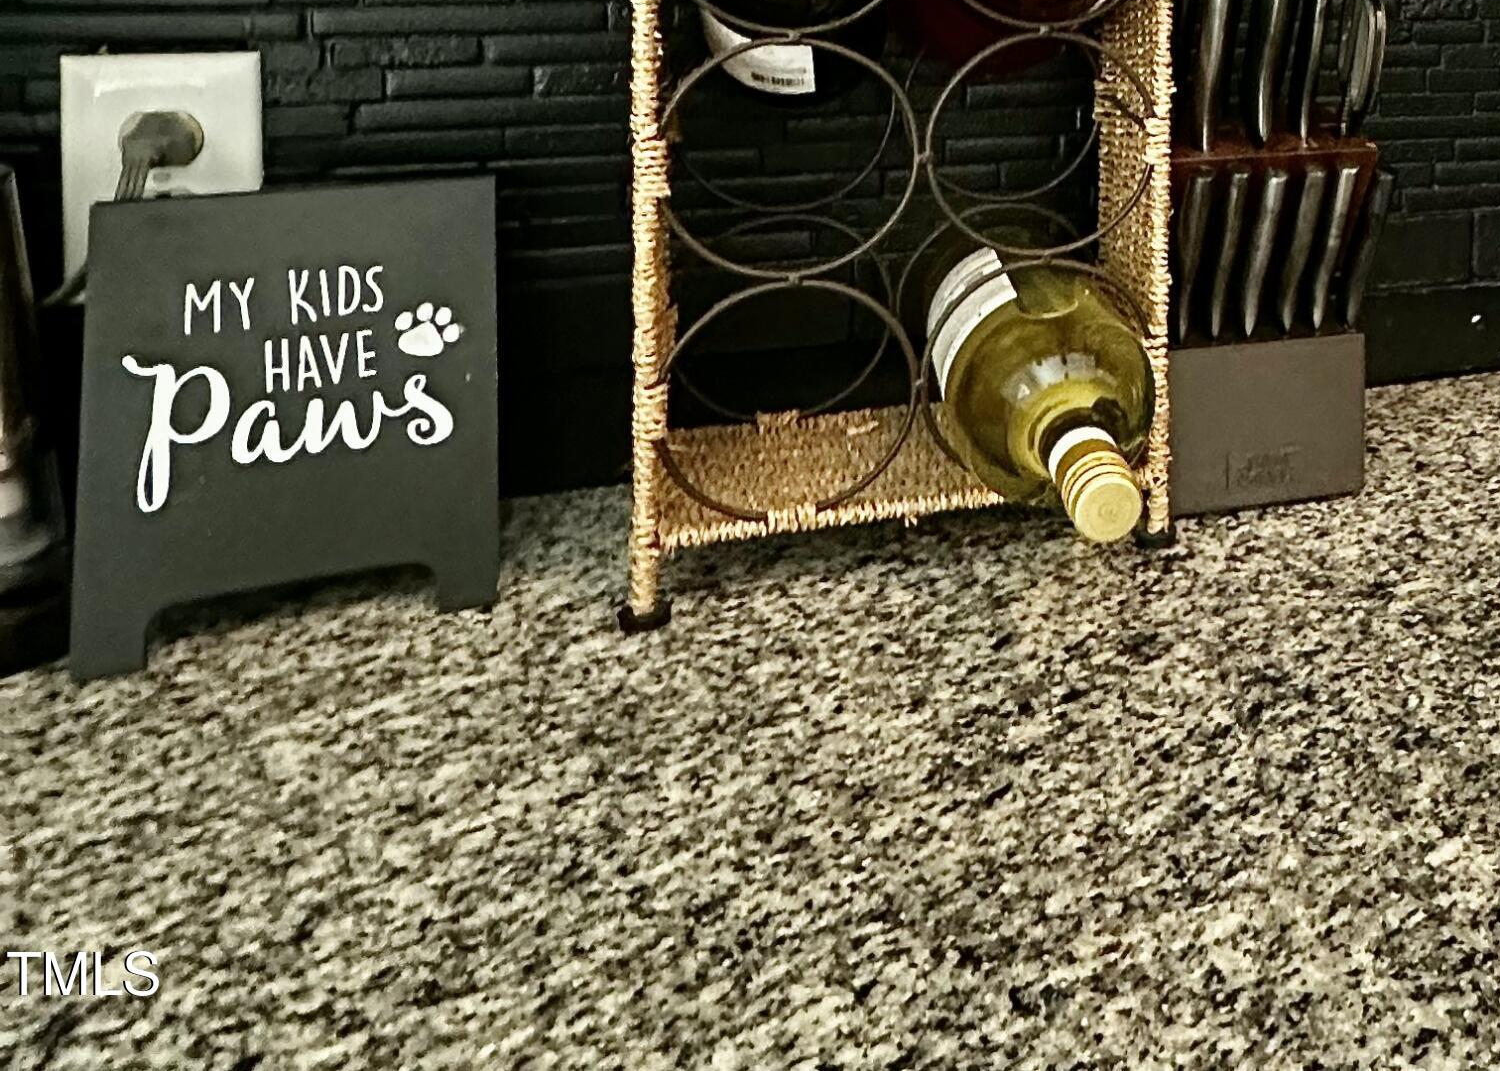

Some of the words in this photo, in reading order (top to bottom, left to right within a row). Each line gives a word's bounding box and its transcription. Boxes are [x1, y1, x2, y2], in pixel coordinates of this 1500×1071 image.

[184, 278, 255, 335] MY
[289, 266, 384, 326] KIDS
[264, 330, 378, 393] HAVE
